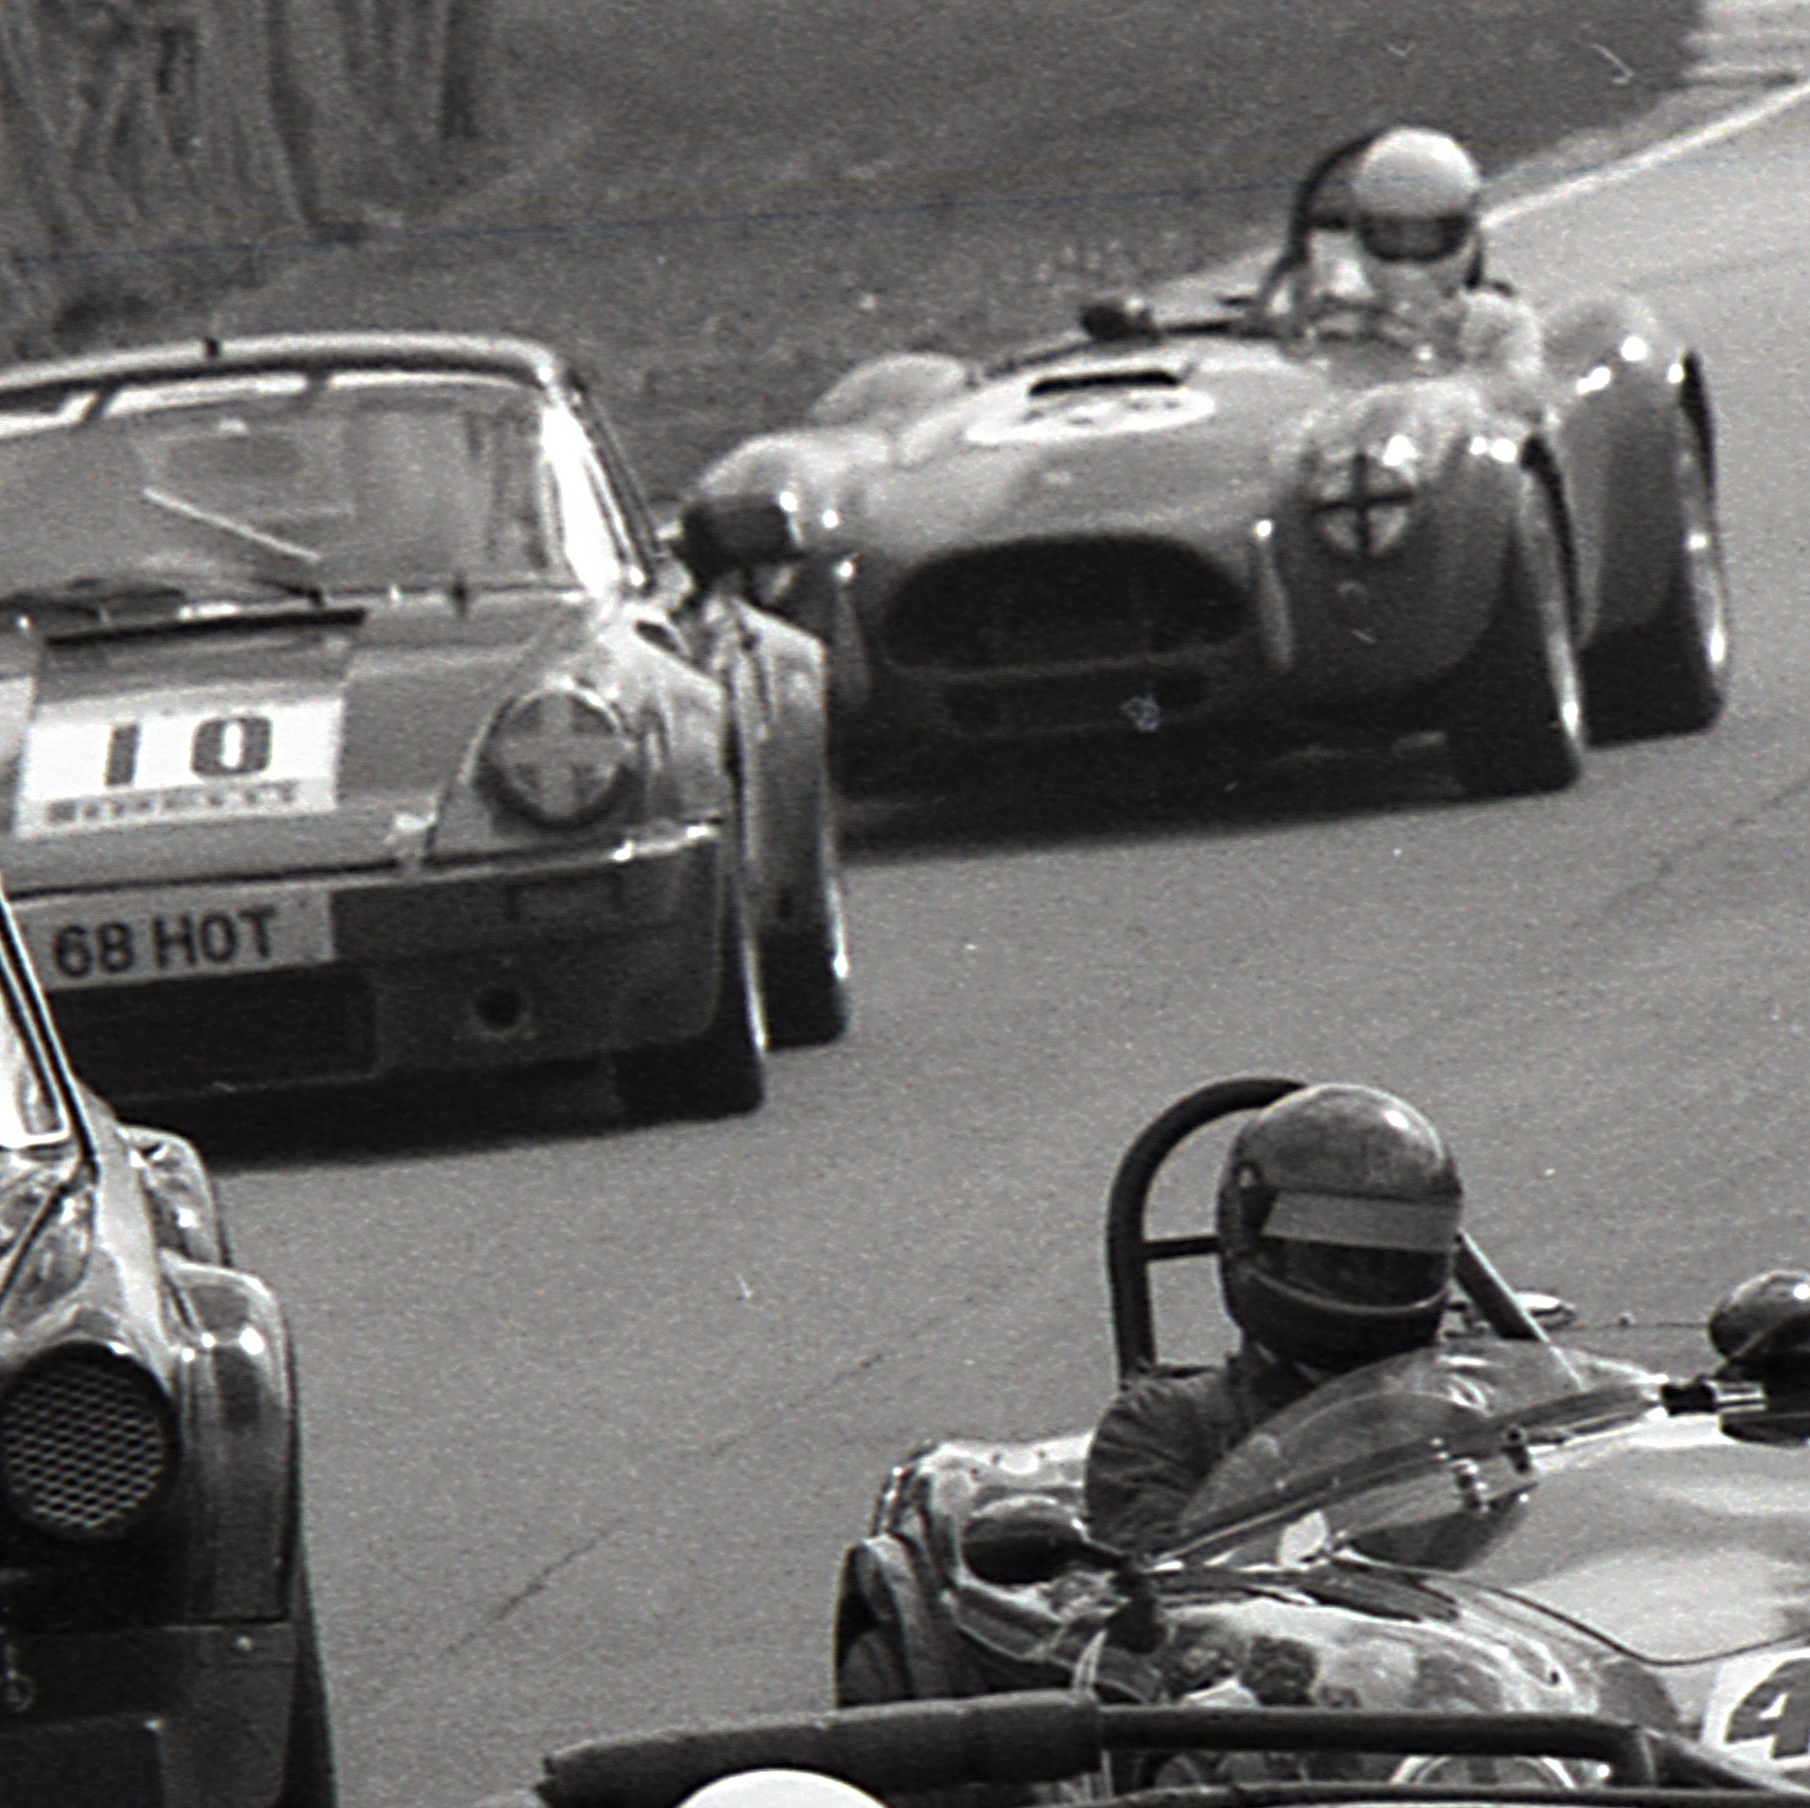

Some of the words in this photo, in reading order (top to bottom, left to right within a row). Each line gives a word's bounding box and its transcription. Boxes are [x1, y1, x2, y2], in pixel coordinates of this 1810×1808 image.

[105, 716, 272, 787] 10
[54, 921, 135, 978] 68
[152, 905, 277, 969] HOT
